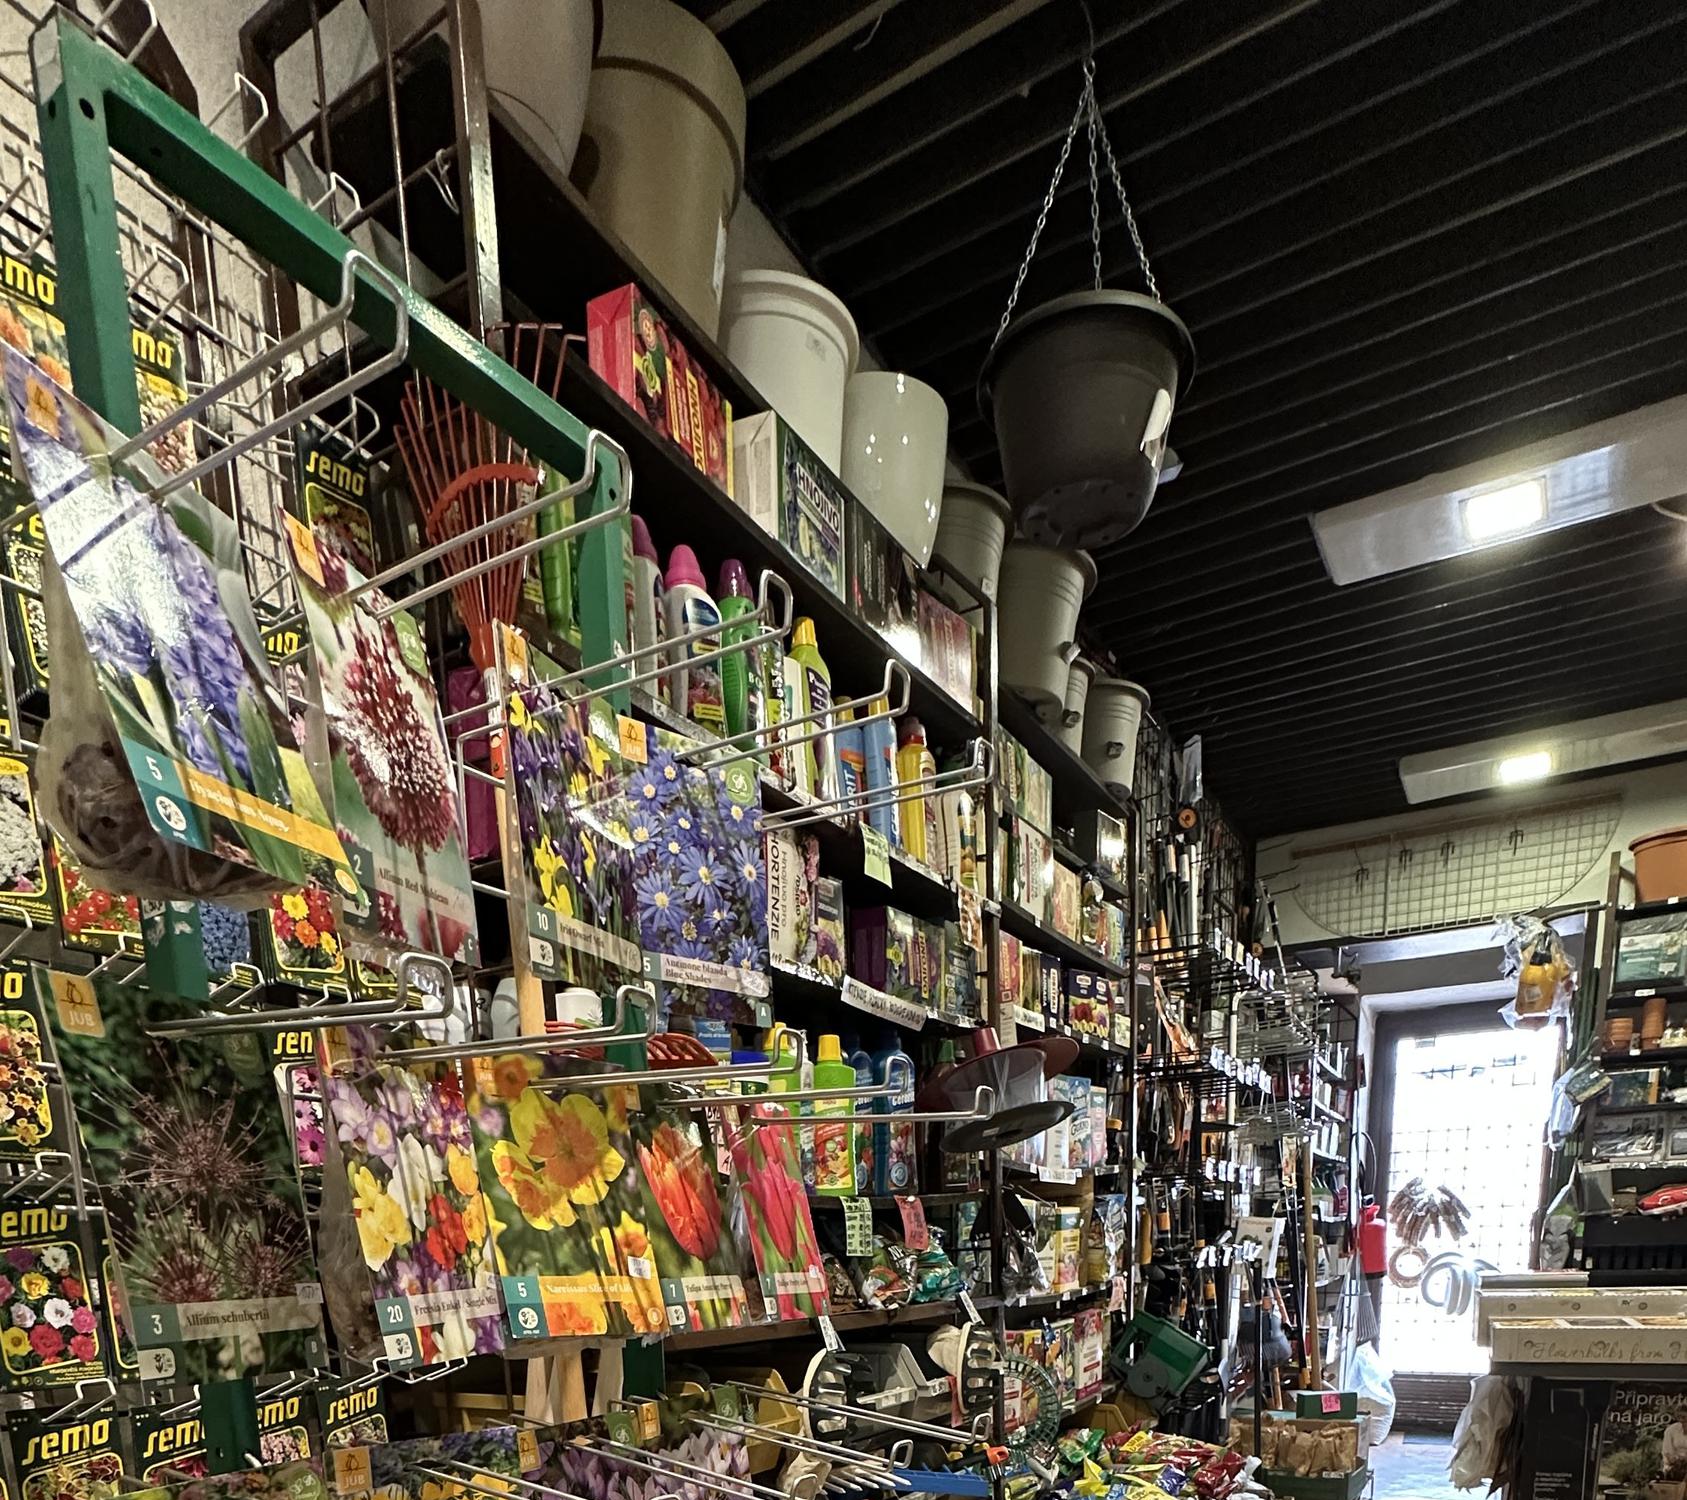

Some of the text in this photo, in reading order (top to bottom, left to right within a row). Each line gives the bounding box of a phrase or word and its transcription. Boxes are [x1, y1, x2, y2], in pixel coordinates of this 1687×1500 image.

[306, 451, 367, 497] semo
[797, 470, 841, 532] HNOJIVO
[145, 756, 163, 781] 5
[353, 854, 362, 875] 2
[405, 877, 419, 894] Red
[770, 831, 781, 943] HORTENZIE
[536, 911, 549, 931] 10
[644, 957, 651, 972] 5
[919, 935, 930, 996] HNOJIVO
[665, 968, 713, 985] Blue Shades
[68, 1009, 96, 1027] JUB
[517, 1282, 528, 1298] 5
[387, 1304, 404, 1324] 20
[151, 1314, 163, 1336] 3
[326, 1386, 378, 1425] semo
[1635, 1409, 1673, 1426] jaro
[22, 1418, 111, 1466] semo
